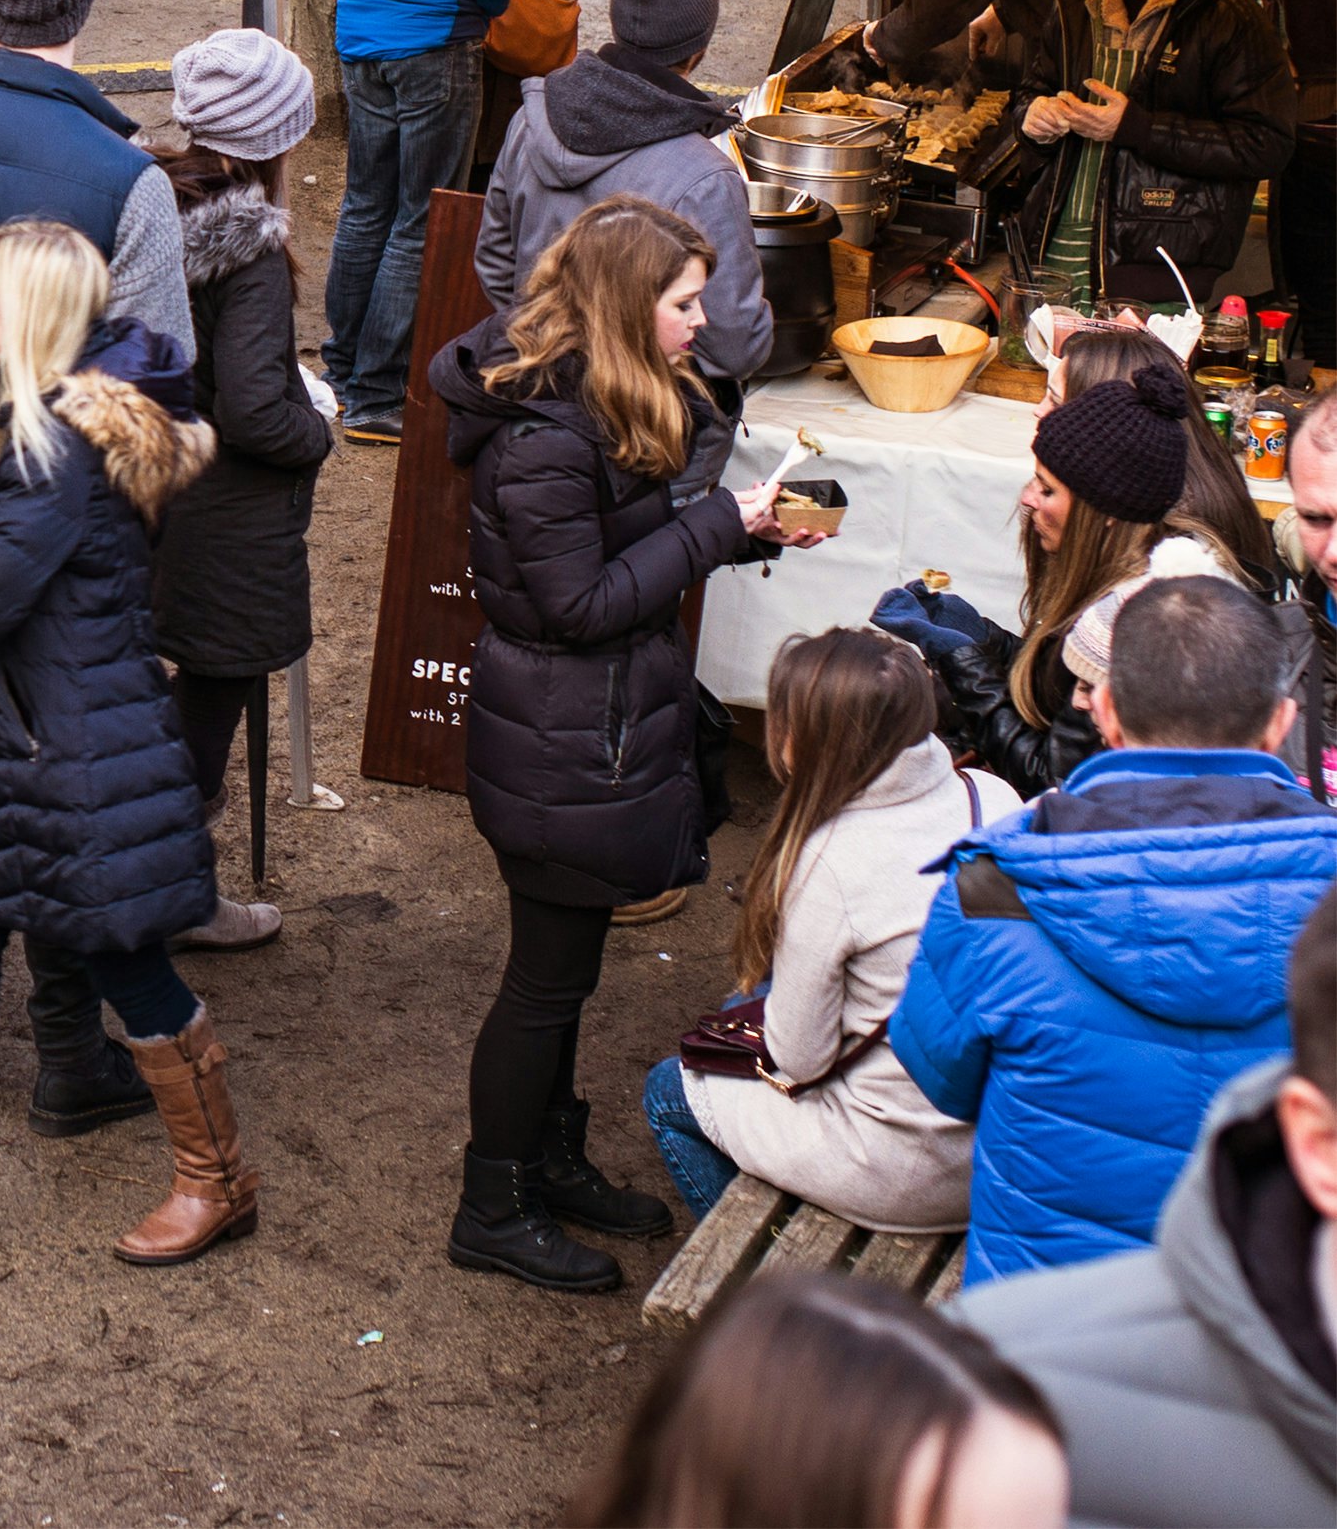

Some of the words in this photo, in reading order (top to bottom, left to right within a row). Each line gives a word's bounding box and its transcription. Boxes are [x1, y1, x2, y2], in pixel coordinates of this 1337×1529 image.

[430, 582, 462, 597] with
[411, 657, 472, 687] SPEC
[410, 708, 446, 724] with
[450, 712, 462, 726] 2
